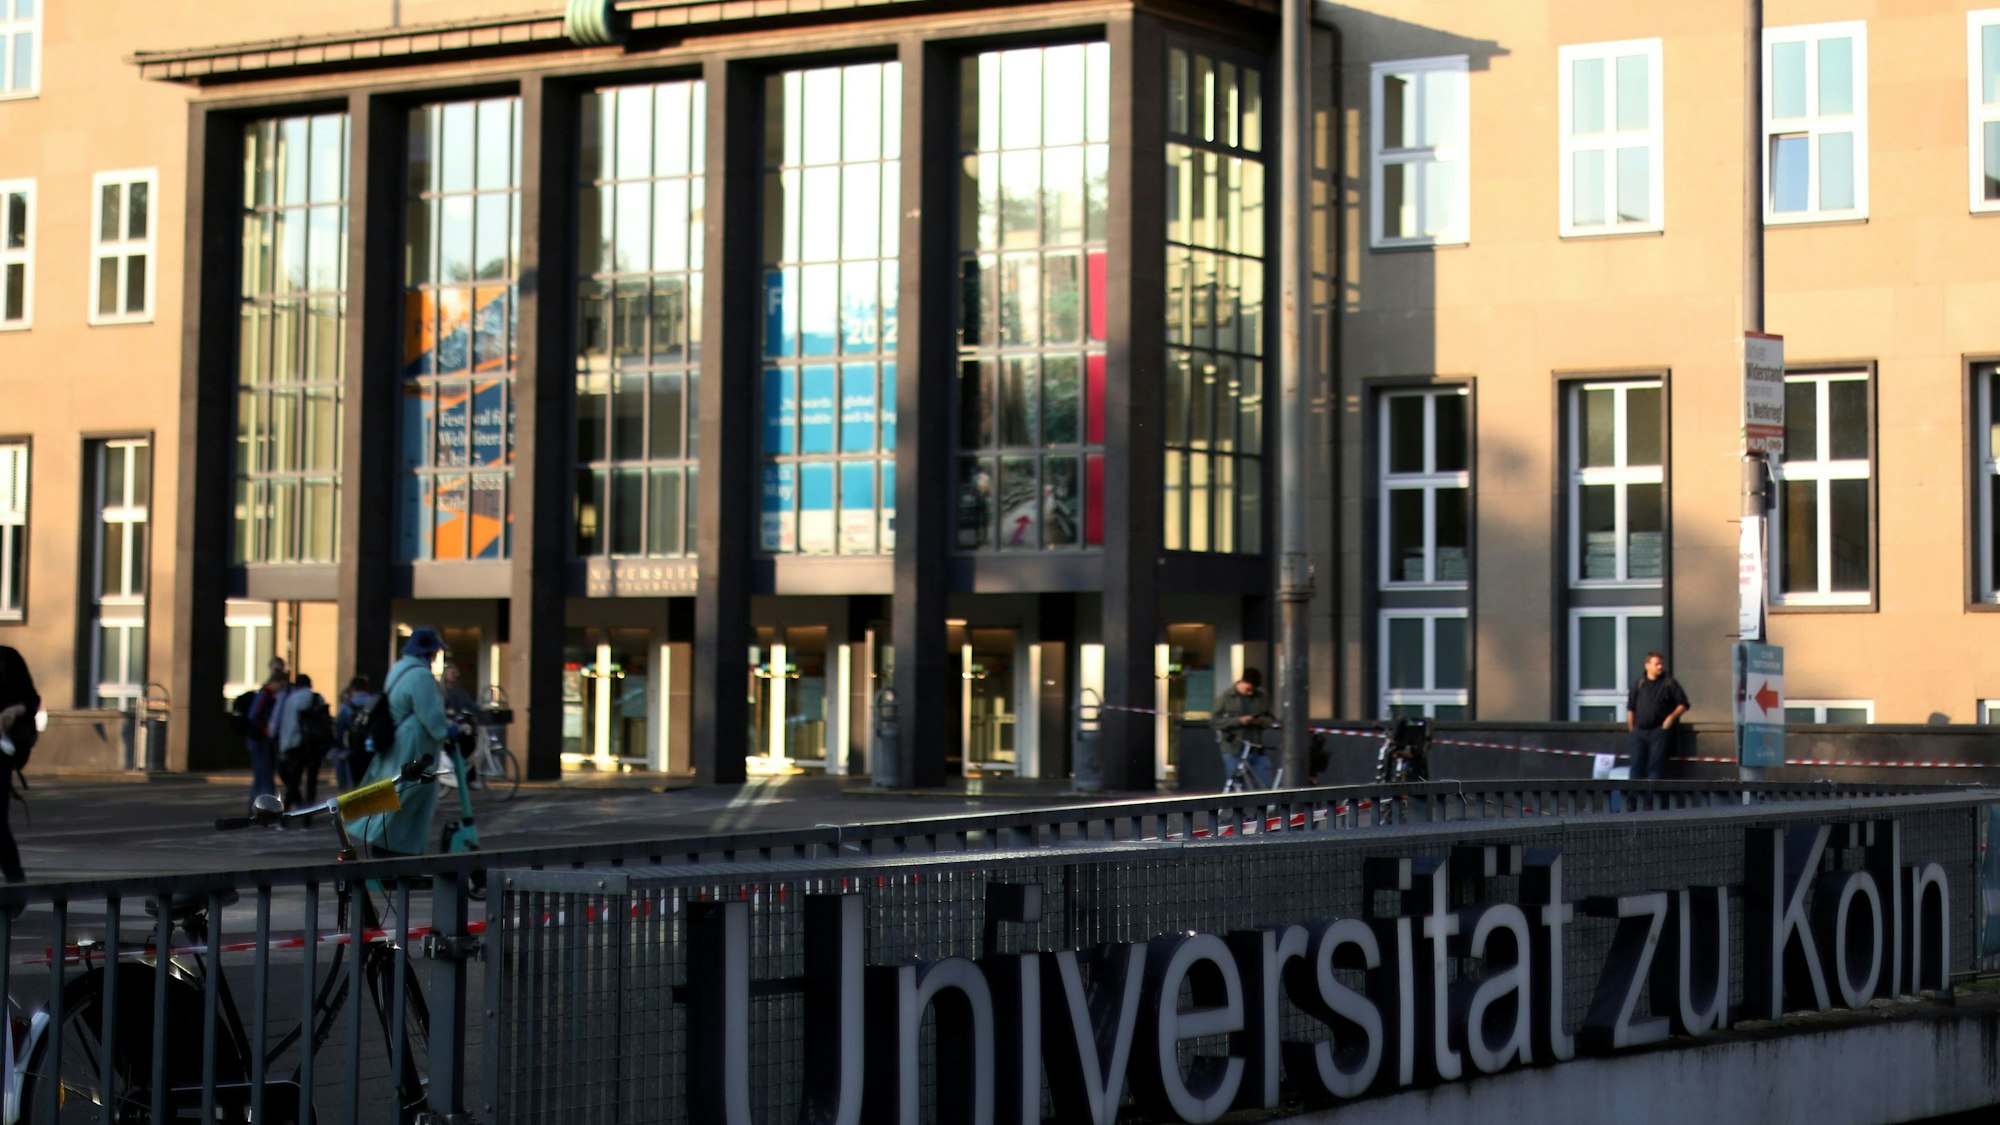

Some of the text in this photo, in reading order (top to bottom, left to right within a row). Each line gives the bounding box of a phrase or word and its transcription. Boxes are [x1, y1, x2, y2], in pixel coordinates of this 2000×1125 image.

[440, 408, 491, 427] Festval
[722, 819, 1951, 1125] Universität zu Köln
